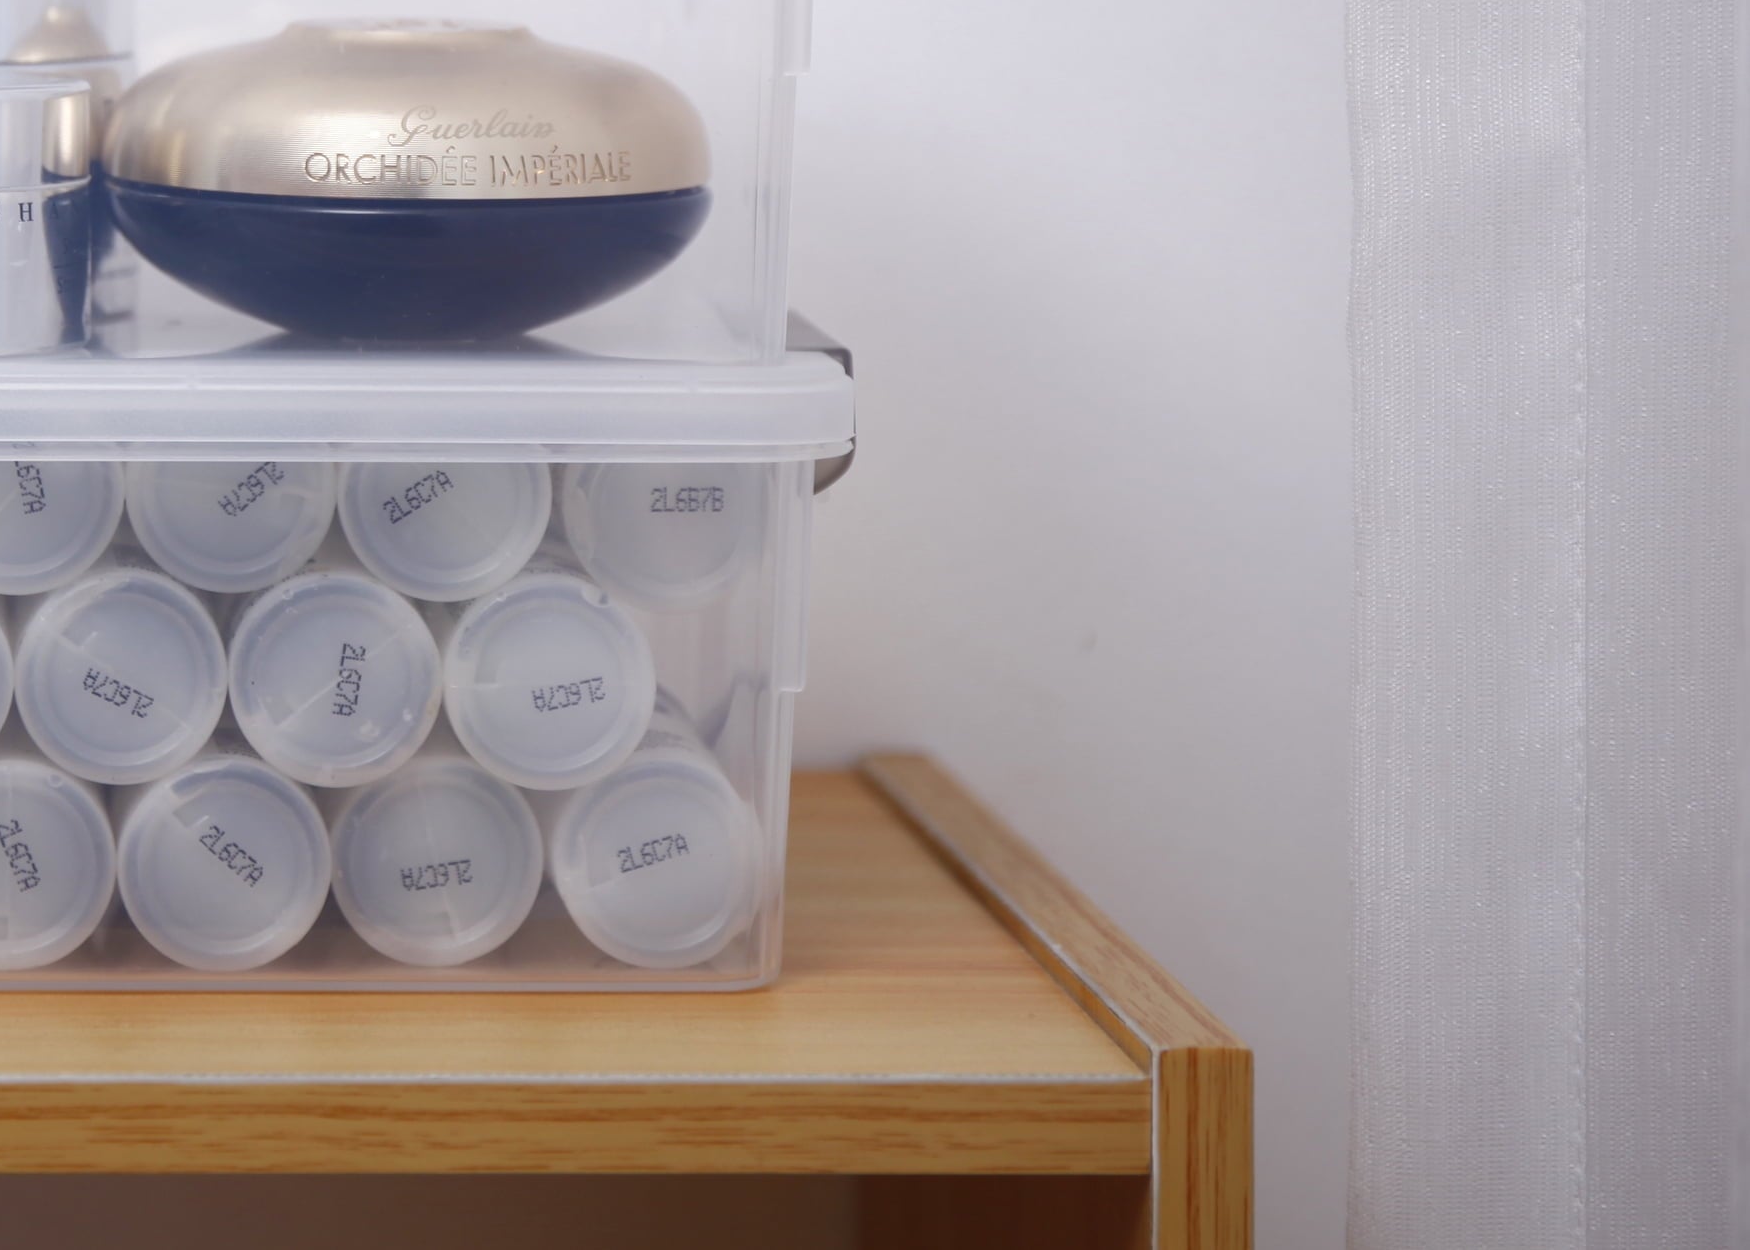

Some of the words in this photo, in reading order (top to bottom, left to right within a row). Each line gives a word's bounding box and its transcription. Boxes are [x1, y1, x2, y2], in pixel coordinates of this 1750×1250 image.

[387, 104, 557, 147] Guerlain
[488, 144, 634, 188] IMPÉRIALE
[382, 469, 454, 524] 2L6C7A
[650, 486, 725, 513] 2L6B7B
[81, 667, 155, 719] 2L6C7A
[331, 642, 367, 717] 2L6C7A
[531, 676, 606, 712] 2L6C7A
[199, 825, 265, 888] 2L6C7A
[616, 833, 691, 874] 2L6C7A
[399, 859, 473, 892] 2L6C7A
